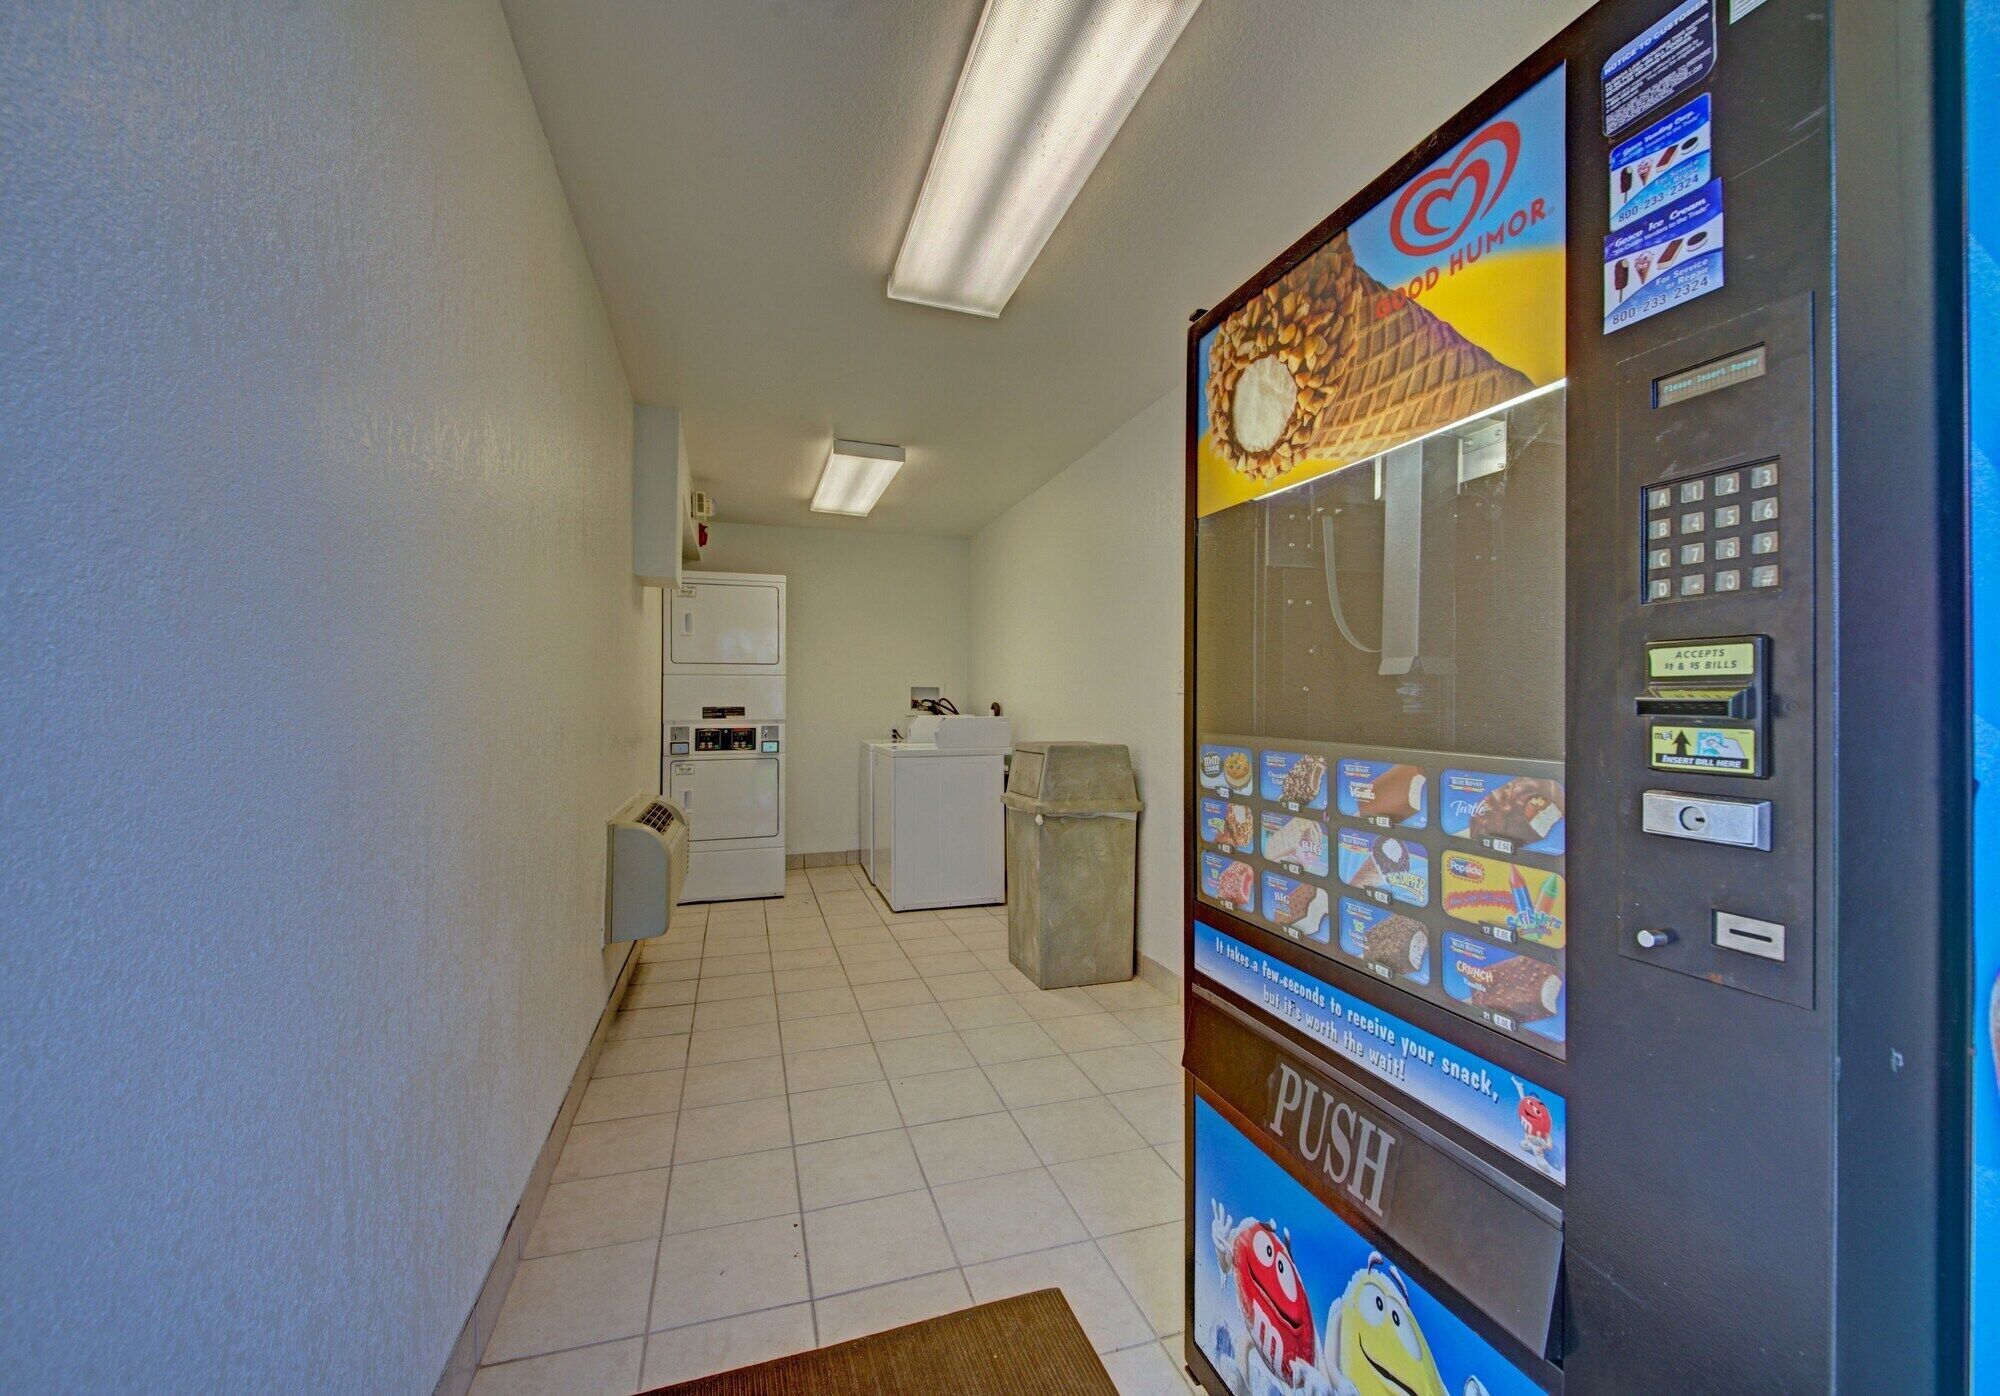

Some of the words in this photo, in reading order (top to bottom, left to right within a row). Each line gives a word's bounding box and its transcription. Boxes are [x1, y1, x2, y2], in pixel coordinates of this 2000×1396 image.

[1604, 47, 1637, 76] NOTICE
[1639, 37, 1652, 50] TO
[1618, 173, 1699, 222] 800-233-2324
[1647, 219, 1665, 232] Ice
[1669, 198, 1707, 220] Cream
[1376, 266, 1440, 319] GOOD
[1450, 197, 1546, 276] HUMOR
[1655, 274, 1671, 286] For
[1673, 258, 1709, 278] Service
[1665, 282, 1675, 290] or
[1678, 266, 1709, 284] Repair
[1612, 275, 1708, 325] 800-233-2324
[1663, 379, 1693, 394] Please
[1696, 367, 1728, 383] Insert
[1726, 477, 1736, 494] 2
[1763, 469, 1773, 486] 3
[1660, 491, 1668, 507] A
[1726, 509, 1736, 525] 5
[1764, 502, 1774, 519] 6
[1660, 522, 1668, 537] B
[1691, 516, 1700, 532] 4
[1726, 541, 1736, 558] 8
[1764, 536, 1773, 553] 9
[1659, 552, 1667, 567] C
[1691, 547, 1700, 562] 7
[1659, 582, 1668, 597] D
[1725, 574, 1736, 590] 0
[1675, 649, 1725, 659] ACCEPTS
[1677, 662, 1685, 671] &
[1689, 661, 1700, 670] $5
[1704, 660, 1738, 670] BILLS
[1661, 754, 1695, 765] INSERT
[1695, 756, 1715, 767] BILL
[1716, 757, 1743, 768] HERE
[1450, 799, 1491, 818] Turtle
[1301, 839, 1322, 857] BIG
[1450, 858, 1484, 878] Popsicle
[1274, 891, 1290, 906] BIG
[1456, 960, 1494, 983] CRUNCH
[1215, 936, 1225, 955] It
[1226, 943, 1250, 967] takes
[1251, 960, 1259, 975] a
[1261, 959, 1280, 985] few
[1282, 977, 1326, 1009] seconds
[1330, 996, 1342, 1017] to
[1347, 1007, 1396, 1047] receive
[1401, 1035, 1436, 1067] your
[1441, 1056, 1499, 1104] snack,
[1263, 984, 1281, 1010] but
[1283, 996, 1302, 1022] it's
[1305, 1011, 1339, 1044] worth
[1343, 1029, 1365, 1058] the
[1368, 1047, 1406, 1082] wait!
[1269, 1062, 1396, 1218] PUSH
[1249, 1297, 1284, 1372] m
